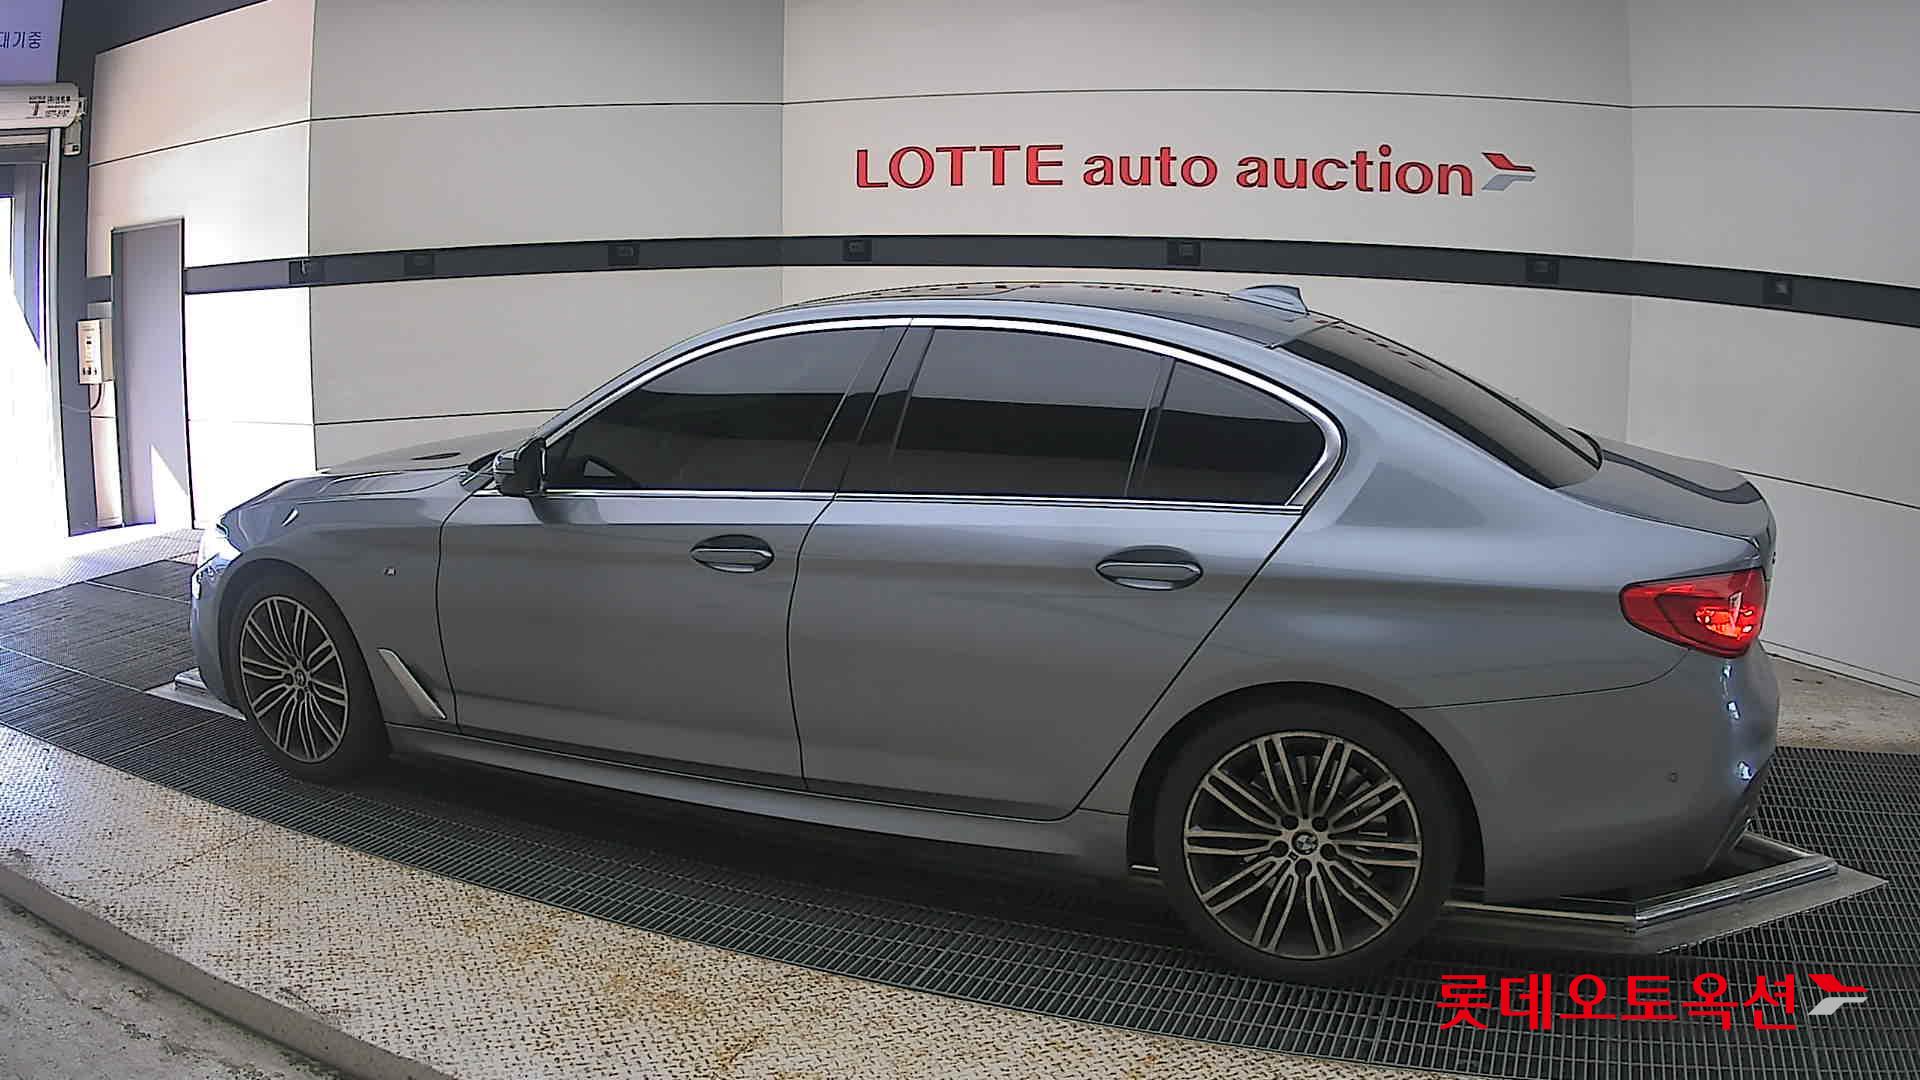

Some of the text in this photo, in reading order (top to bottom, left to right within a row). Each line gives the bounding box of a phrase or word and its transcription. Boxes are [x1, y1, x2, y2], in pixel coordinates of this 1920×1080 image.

[856, 144, 1474, 196] LOTTE auto auction
